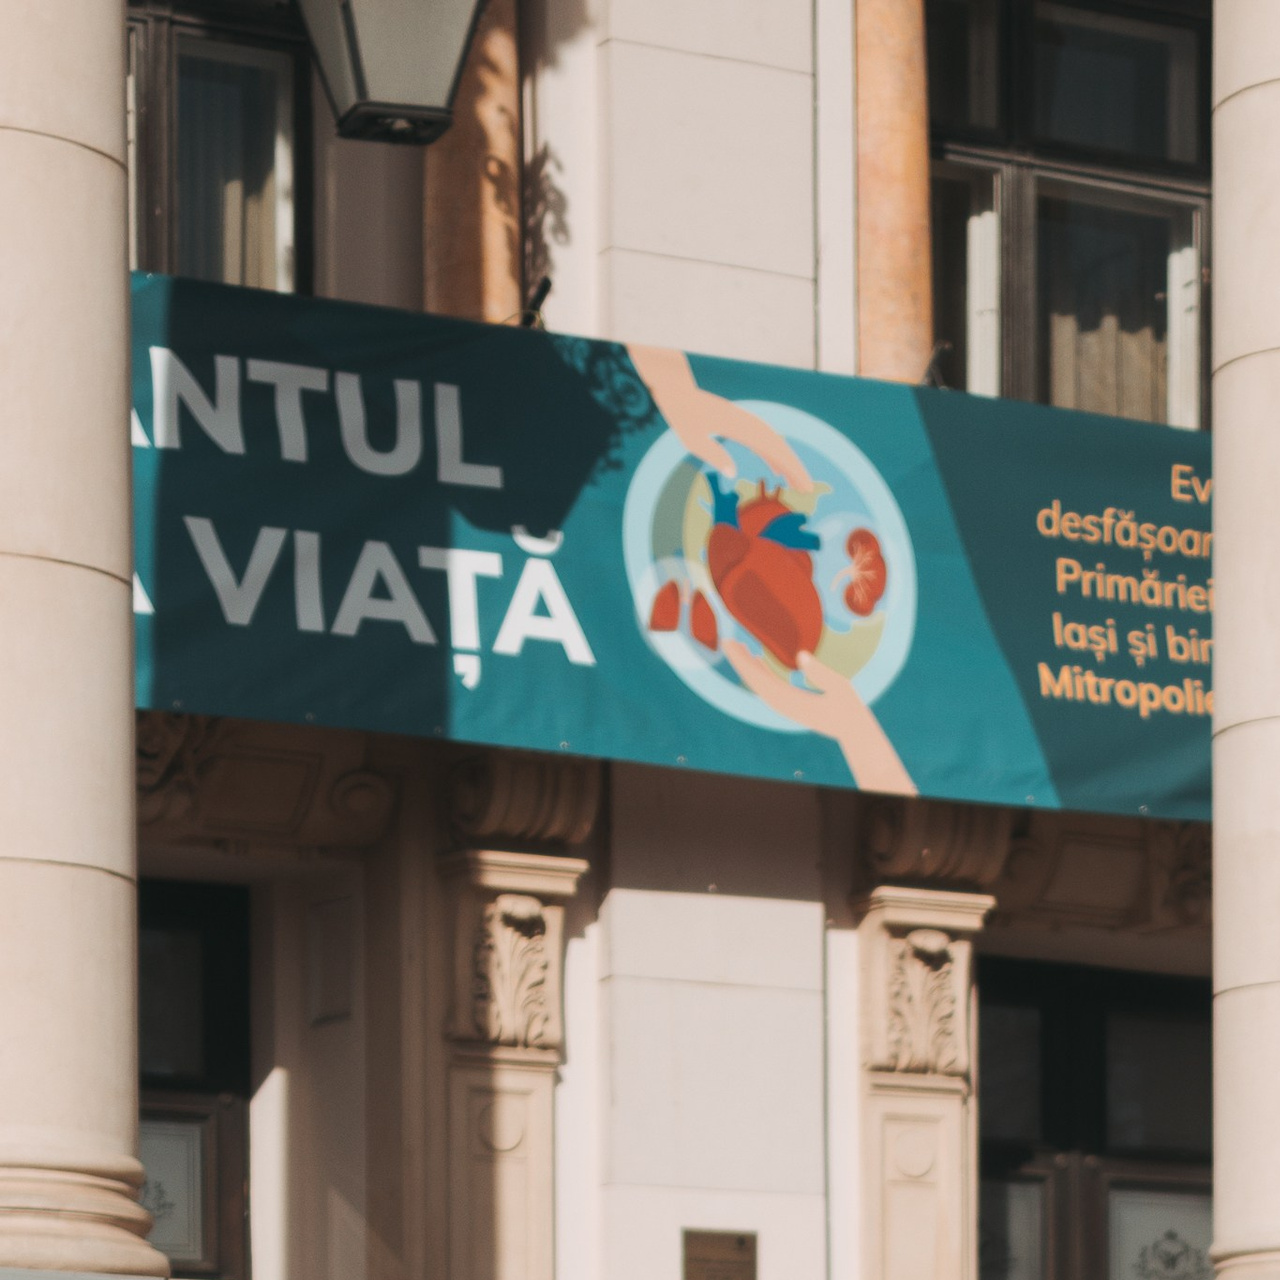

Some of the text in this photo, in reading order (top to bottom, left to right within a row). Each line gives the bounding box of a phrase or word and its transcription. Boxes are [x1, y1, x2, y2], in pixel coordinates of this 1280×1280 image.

[132, 346, 503, 489] NTUL
[1171, 463, 1213, 503] Ev
[183, 515, 596, 690] VIAȚĂ
[1056, 557, 1214, 612] Primăriei
[1052, 612, 1118, 662] Iași
[1127, 623, 1158, 667] și
